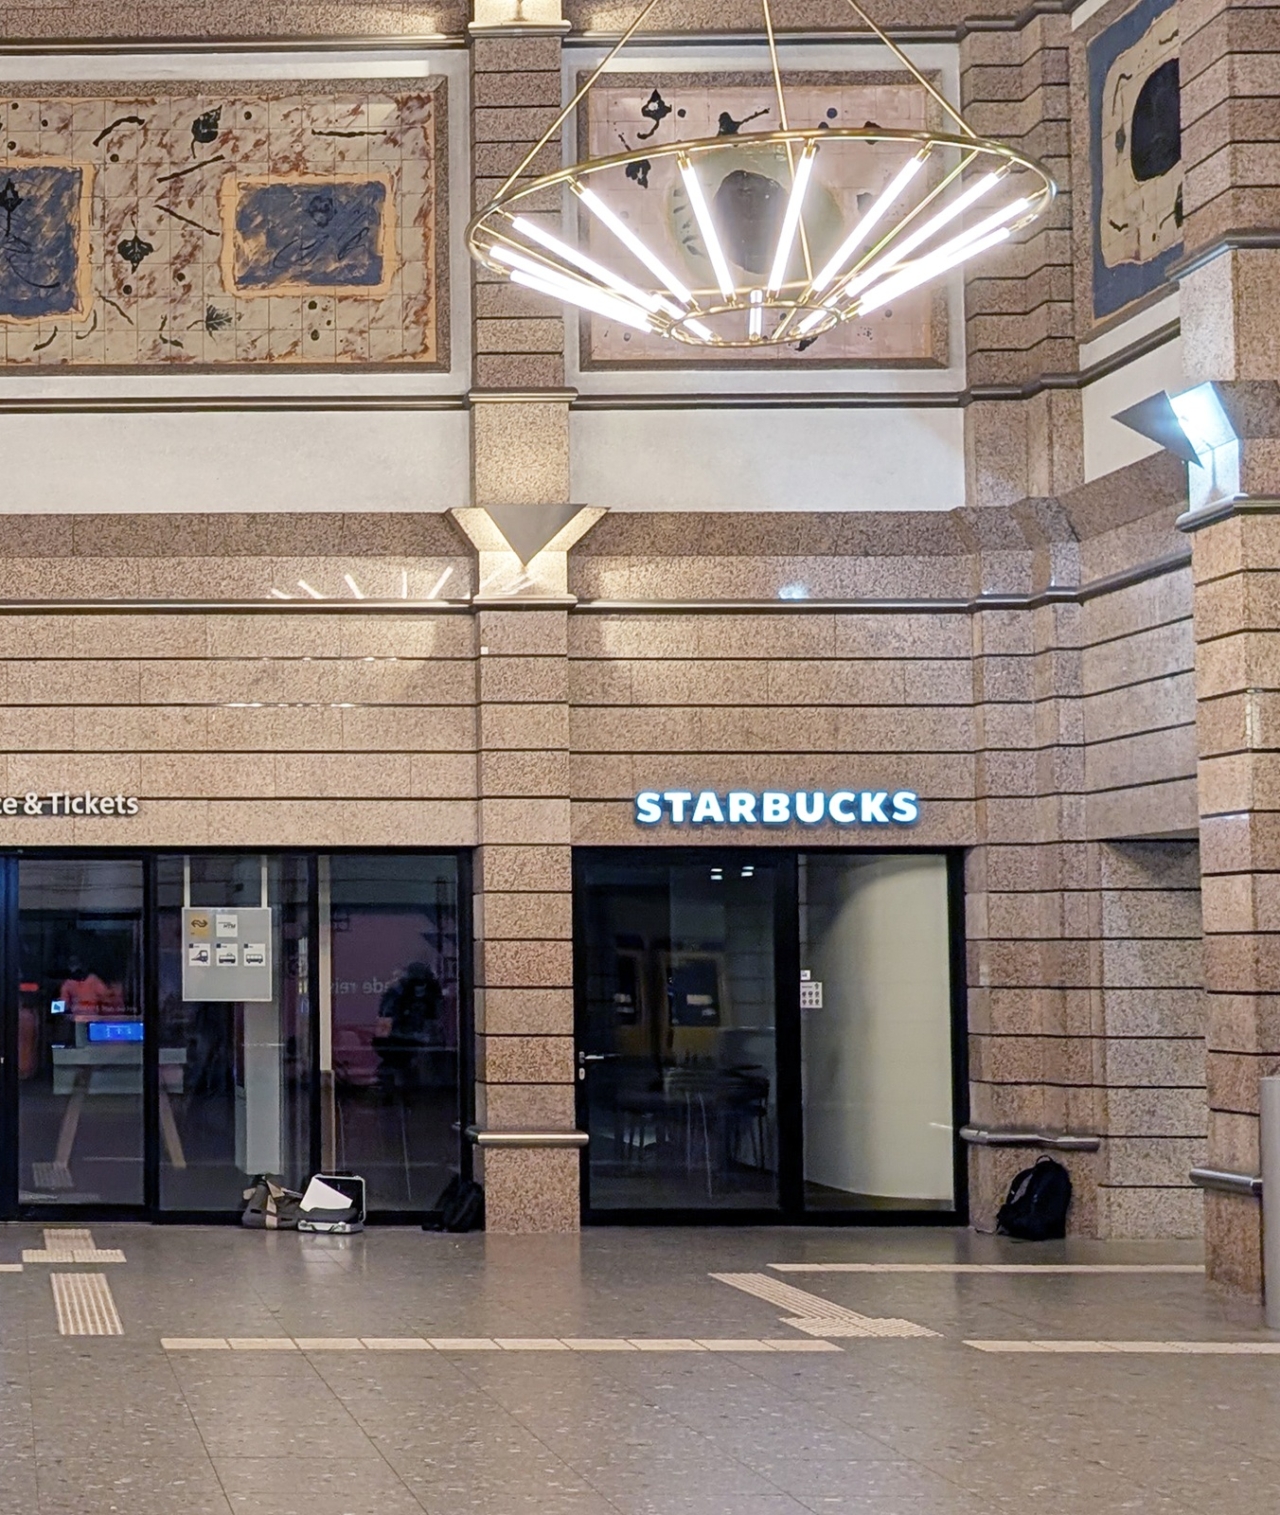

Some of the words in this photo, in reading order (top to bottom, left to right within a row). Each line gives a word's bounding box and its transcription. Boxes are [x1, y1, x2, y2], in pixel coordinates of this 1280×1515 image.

[23, 793, 43, 816] &
[48, 791, 140, 816] Tickets
[637, 791, 918, 823] STARBUCKS
